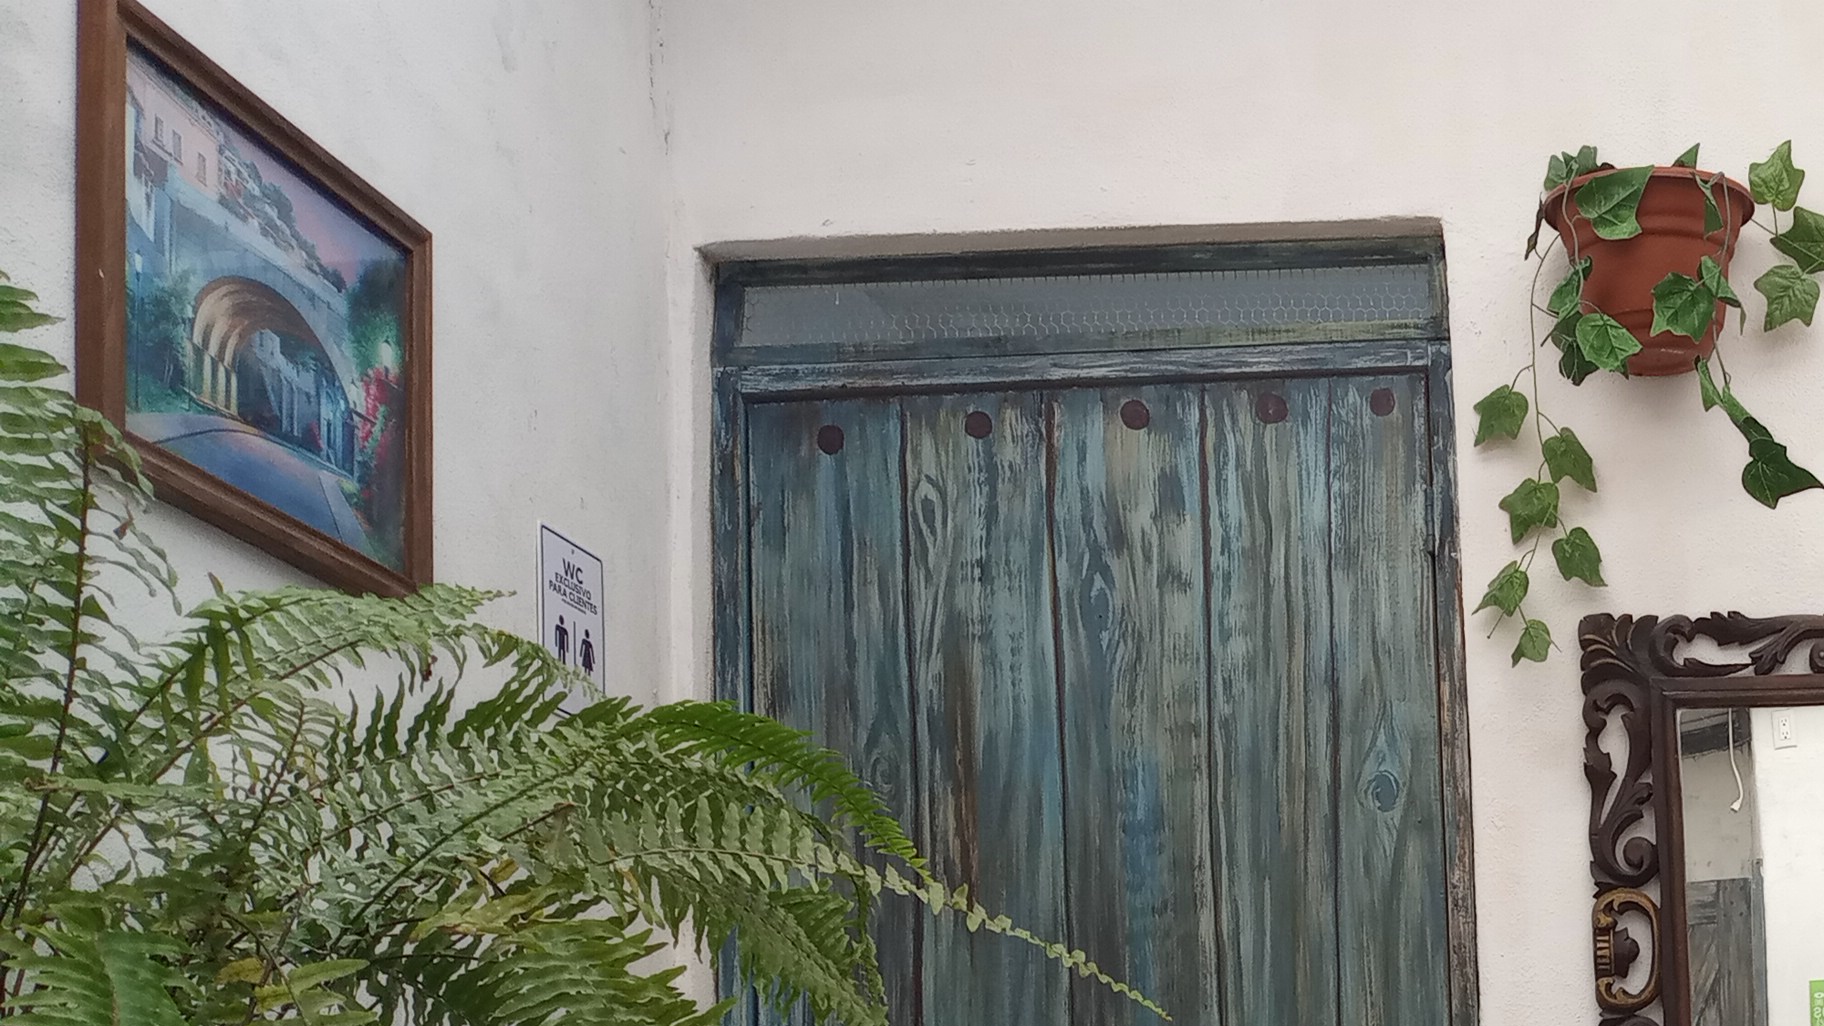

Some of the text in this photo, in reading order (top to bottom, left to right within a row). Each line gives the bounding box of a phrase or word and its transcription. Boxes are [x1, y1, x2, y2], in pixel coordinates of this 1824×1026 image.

[554, 571, 591, 600] EXCLUSIVO
[562, 557, 584, 585] WC
[548, 579, 567, 598] PARA
[569, 591, 598, 615] CLIENTES
